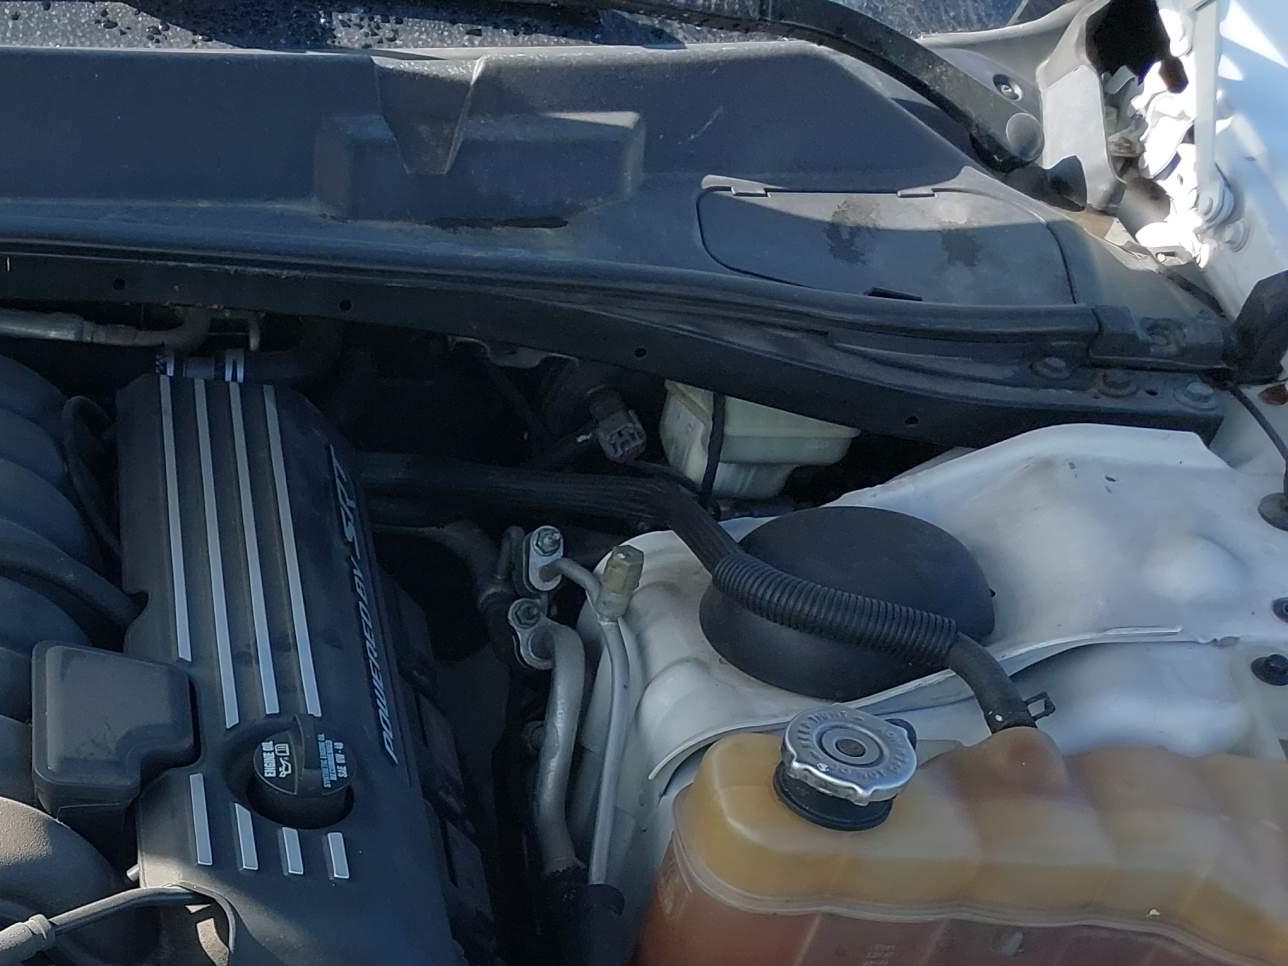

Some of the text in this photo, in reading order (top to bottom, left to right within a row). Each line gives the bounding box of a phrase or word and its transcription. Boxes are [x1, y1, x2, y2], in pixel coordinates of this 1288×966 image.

[329, 444, 398, 764] POWERED BY SRT
[263, 752, 276, 777] ENGINE
